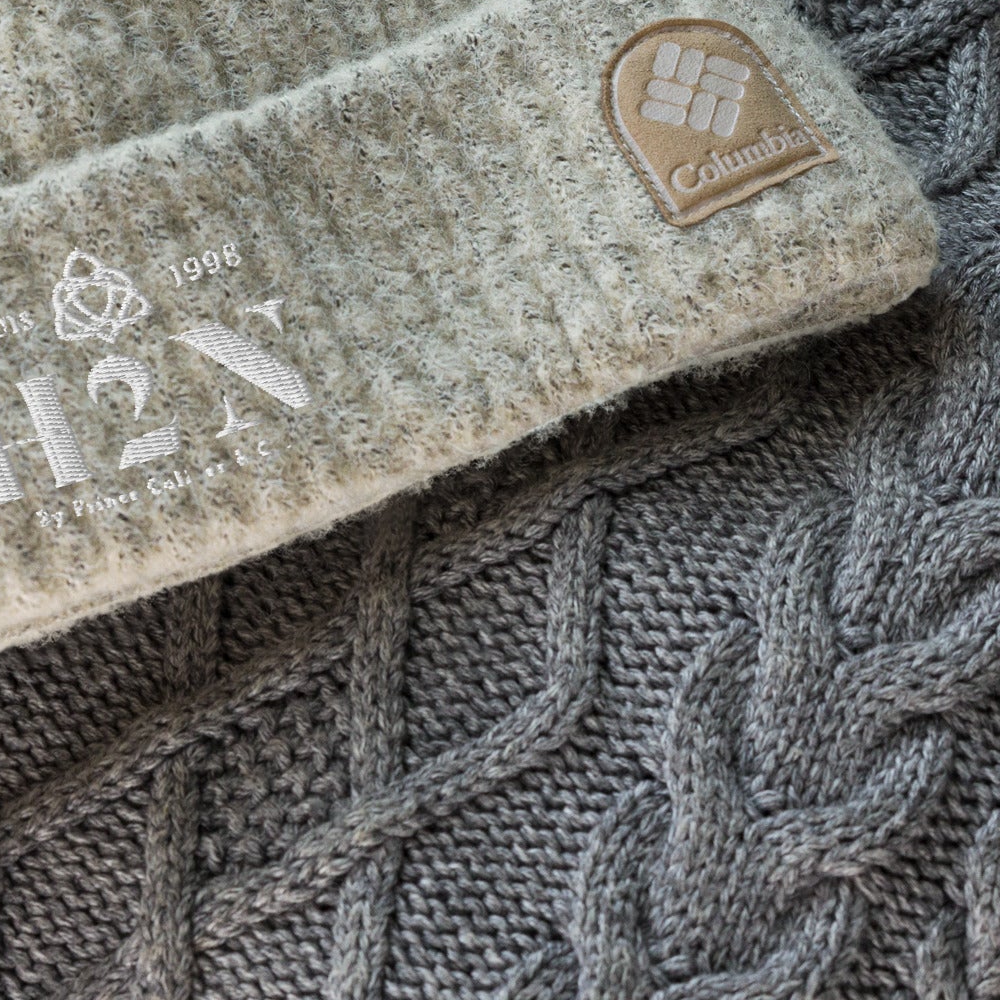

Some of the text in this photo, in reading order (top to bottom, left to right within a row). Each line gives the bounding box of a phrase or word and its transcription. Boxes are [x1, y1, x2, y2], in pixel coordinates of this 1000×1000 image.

[670, 126, 810, 193] Columbia
[168, 242, 243, 288] 1998
[35, 509, 63, 529] By
